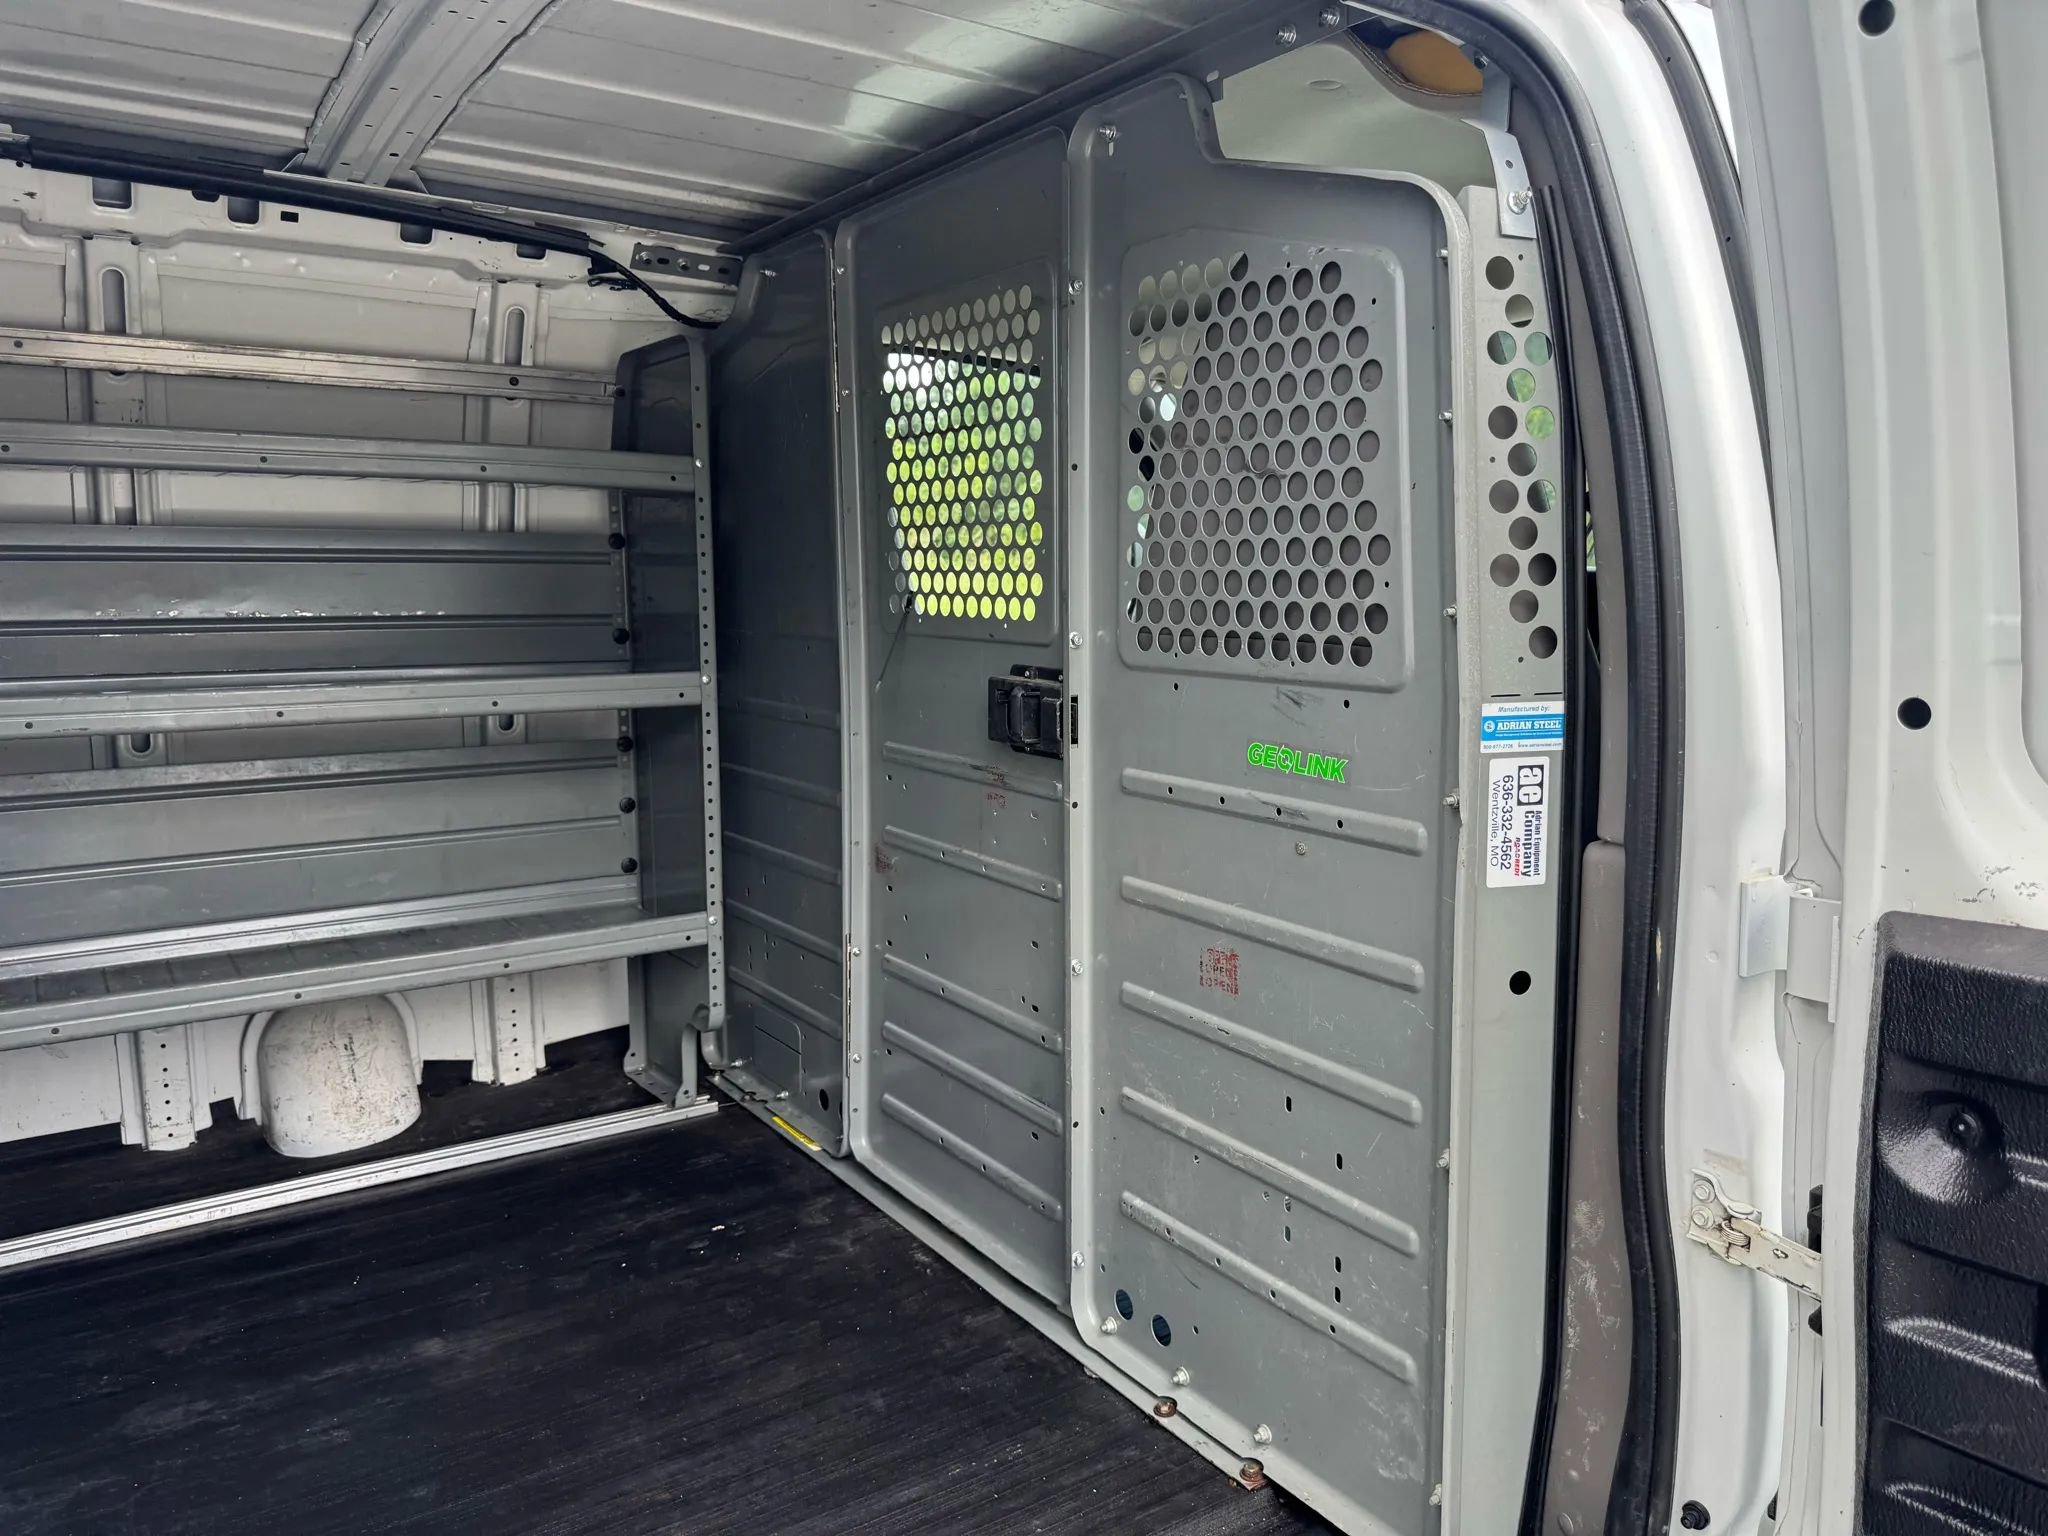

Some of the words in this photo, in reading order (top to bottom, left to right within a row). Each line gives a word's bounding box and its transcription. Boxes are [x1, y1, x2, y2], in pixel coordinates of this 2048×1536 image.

[1498, 705, 1540, 713] Manufactured
[1497, 721, 1532, 730] ADRIAN
[1533, 720, 1561, 729] STEEL
[1490, 780, 1500, 842] Wentzville,
[1501, 775, 1514, 870] 636-332-4562
[1534, 810, 1542, 835] Adrian
[1490, 846, 1499, 867] MO
[1521, 810, 1535, 877] Company
[1533, 838, 1541, 876] Equipment
